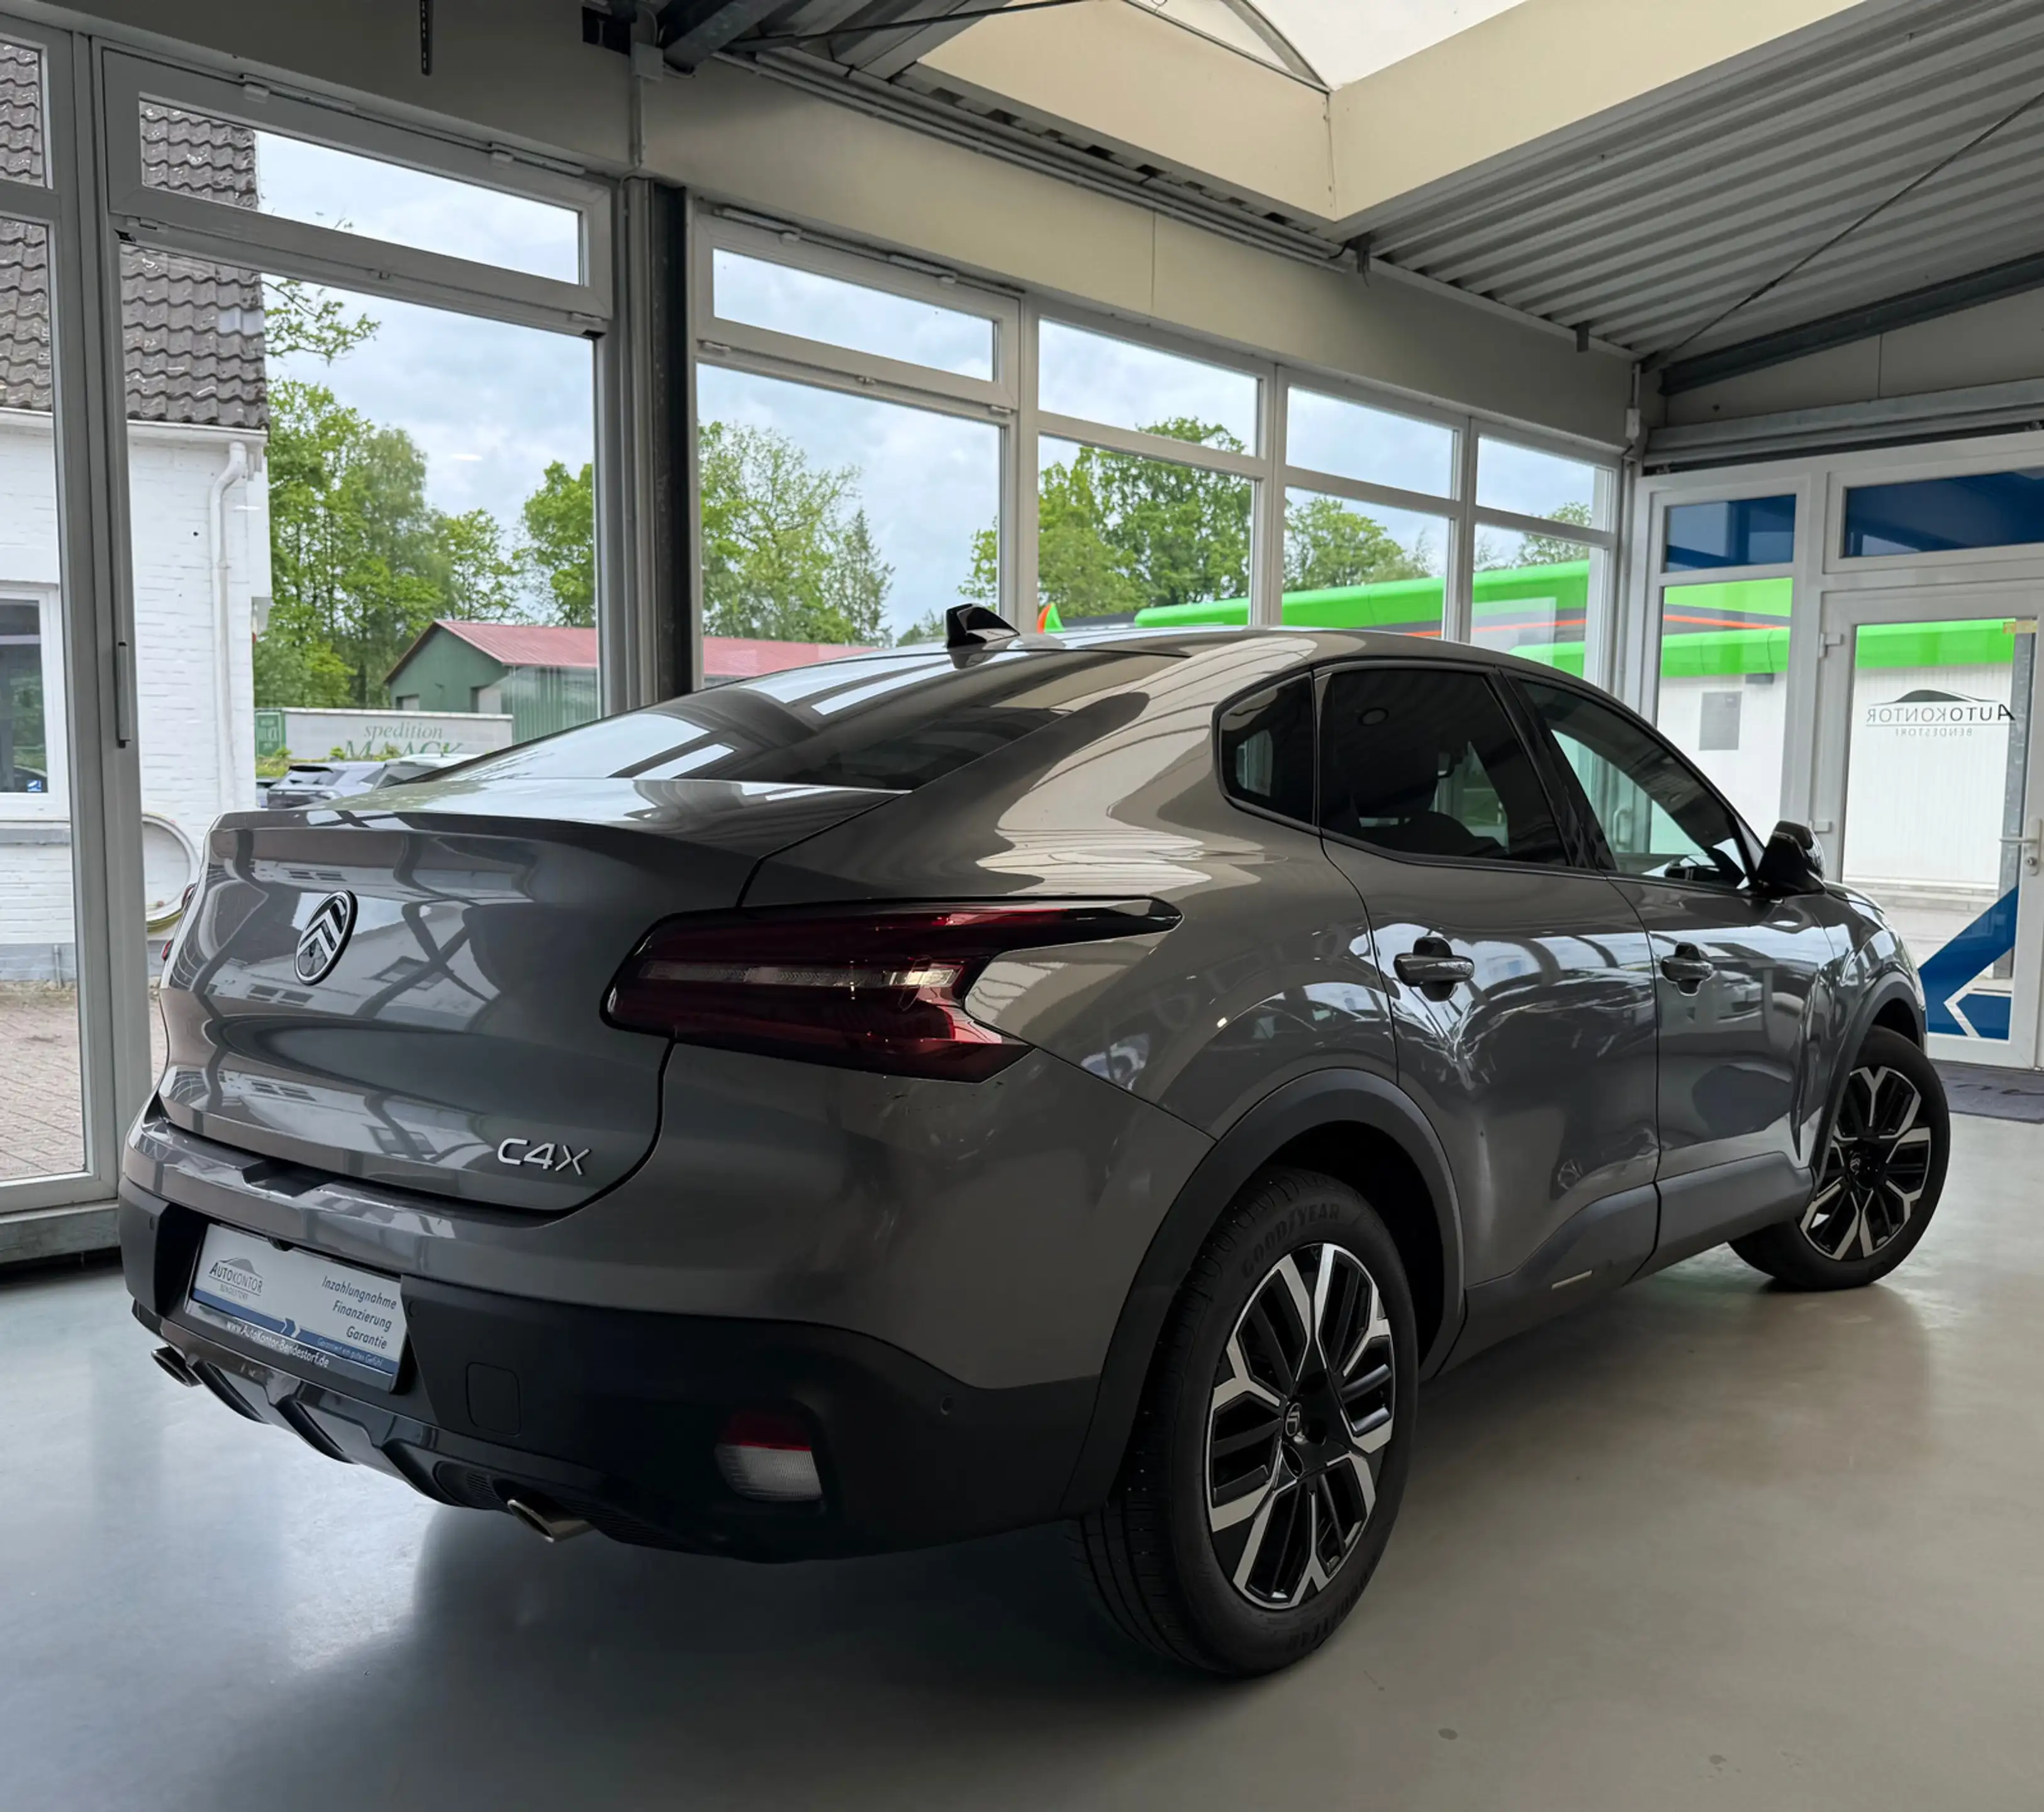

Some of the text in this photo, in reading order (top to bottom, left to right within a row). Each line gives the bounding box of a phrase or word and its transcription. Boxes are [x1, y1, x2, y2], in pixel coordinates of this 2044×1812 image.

[364, 721, 443, 742] spedition
[1241, 1202, 1341, 1278] GOODYEAR
[209, 1261, 263, 1294] AUTOKONTOR
[322, 1276, 396, 1309] Inzahlungnahme
[332, 1300, 391, 1333] Finanzierung
[346, 1326, 387, 1349] Garantie
